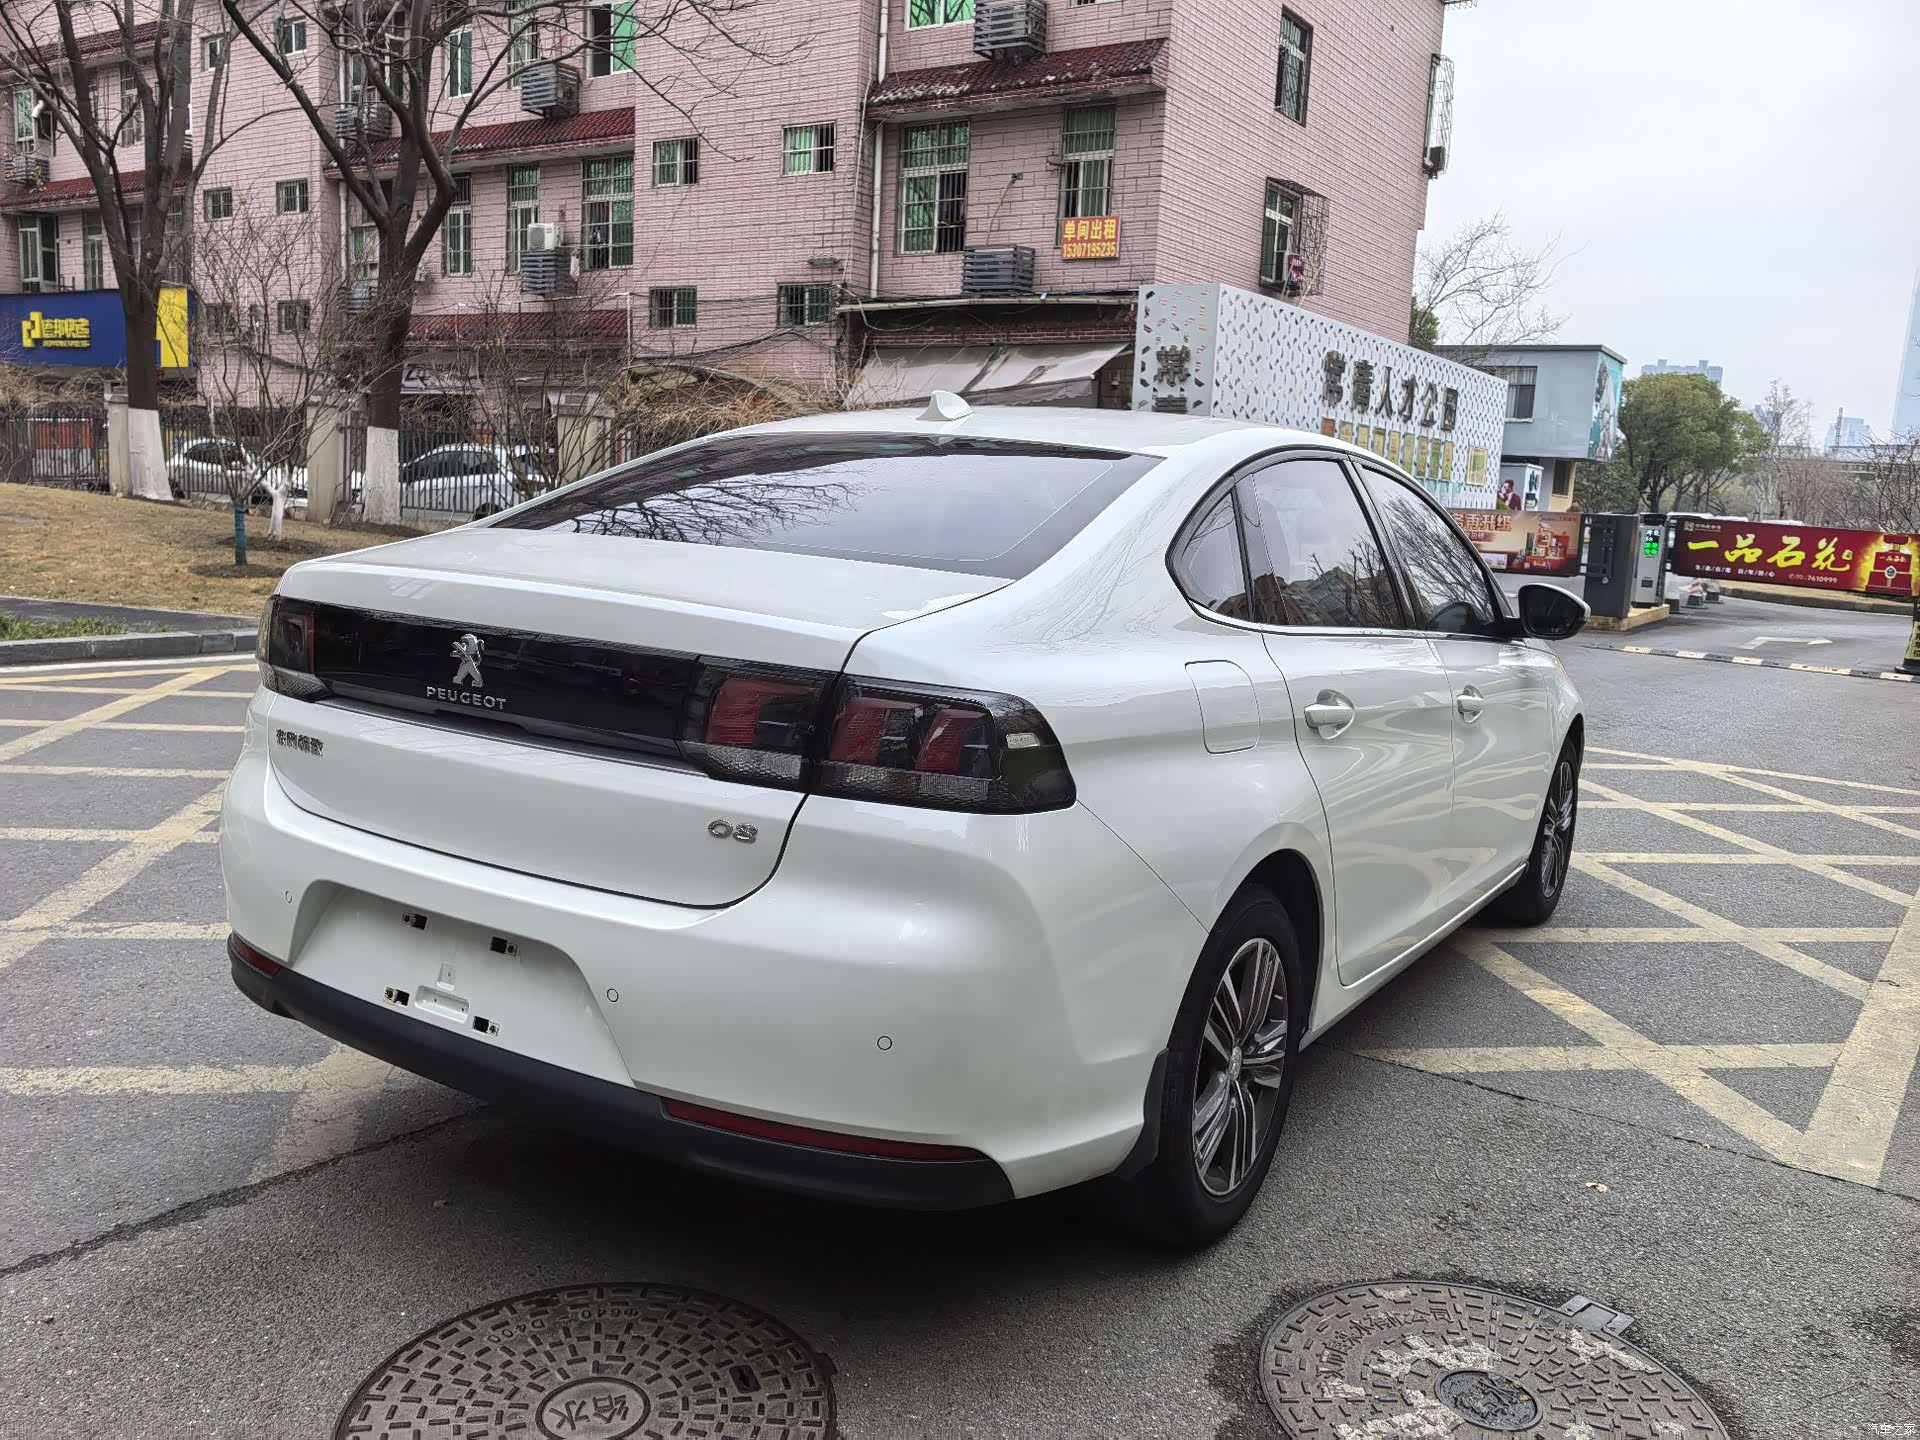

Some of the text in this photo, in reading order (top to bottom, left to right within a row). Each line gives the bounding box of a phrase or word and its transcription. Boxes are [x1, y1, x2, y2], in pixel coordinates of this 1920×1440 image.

[1063, 218, 1117, 241] 单间出租
[1687, 533, 1851, 572] 一品石花
[426, 686, 507, 710] PEUGEOT
[548, 1394, 629, 1430] 给水
